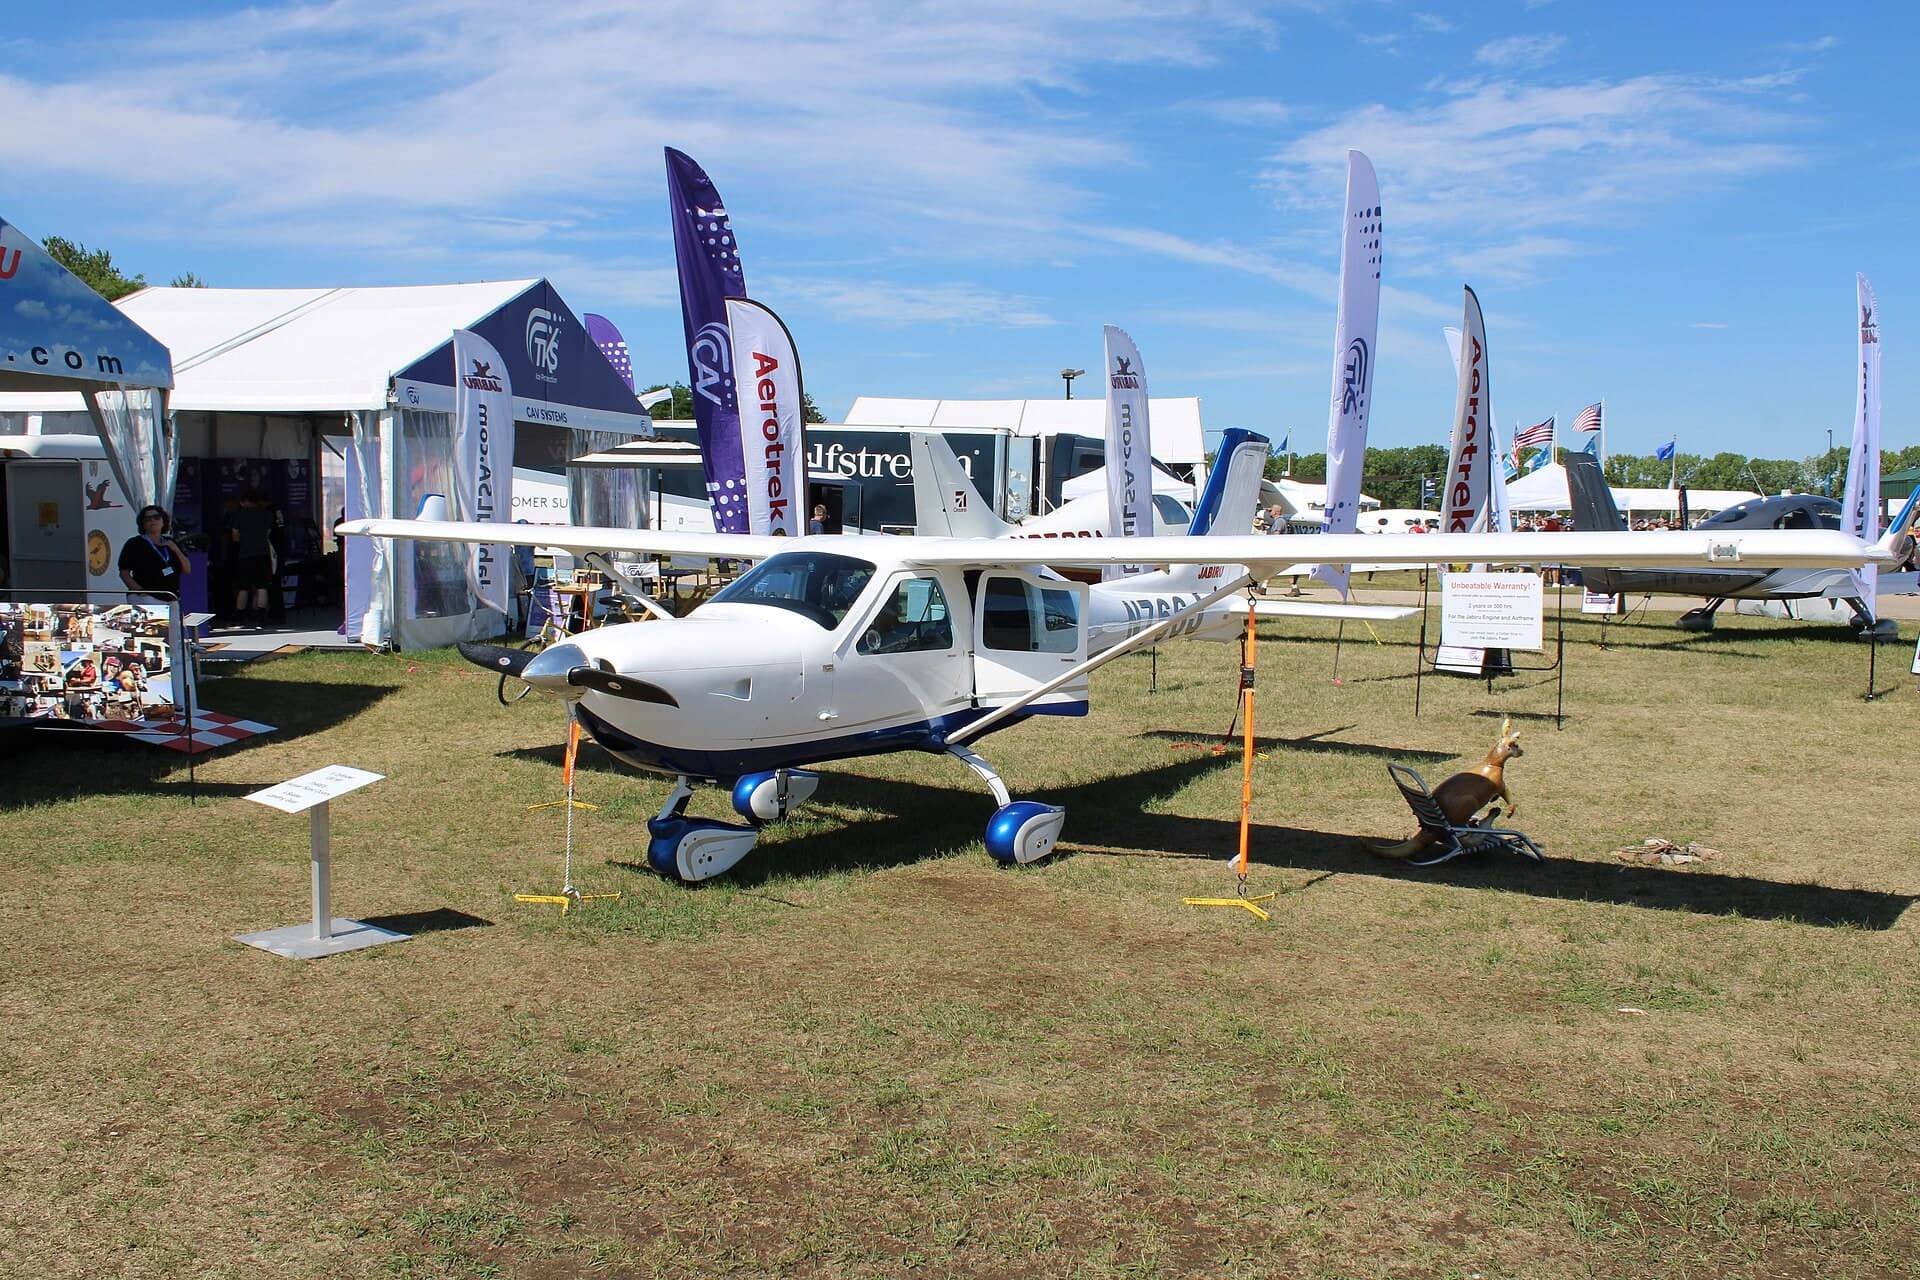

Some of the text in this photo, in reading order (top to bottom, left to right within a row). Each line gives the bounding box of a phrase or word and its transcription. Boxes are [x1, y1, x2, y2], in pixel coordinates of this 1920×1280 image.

[534, 327, 559, 374] TKS
[691, 338, 722, 406] CAV
[526, 406, 568, 423] CAV SYSTEMS
[752, 352, 788, 522] Aerotrek
[1198, 566, 1224, 579] JABIRU
[1451, 582, 1531, 591] Unbeatable Warranty!
